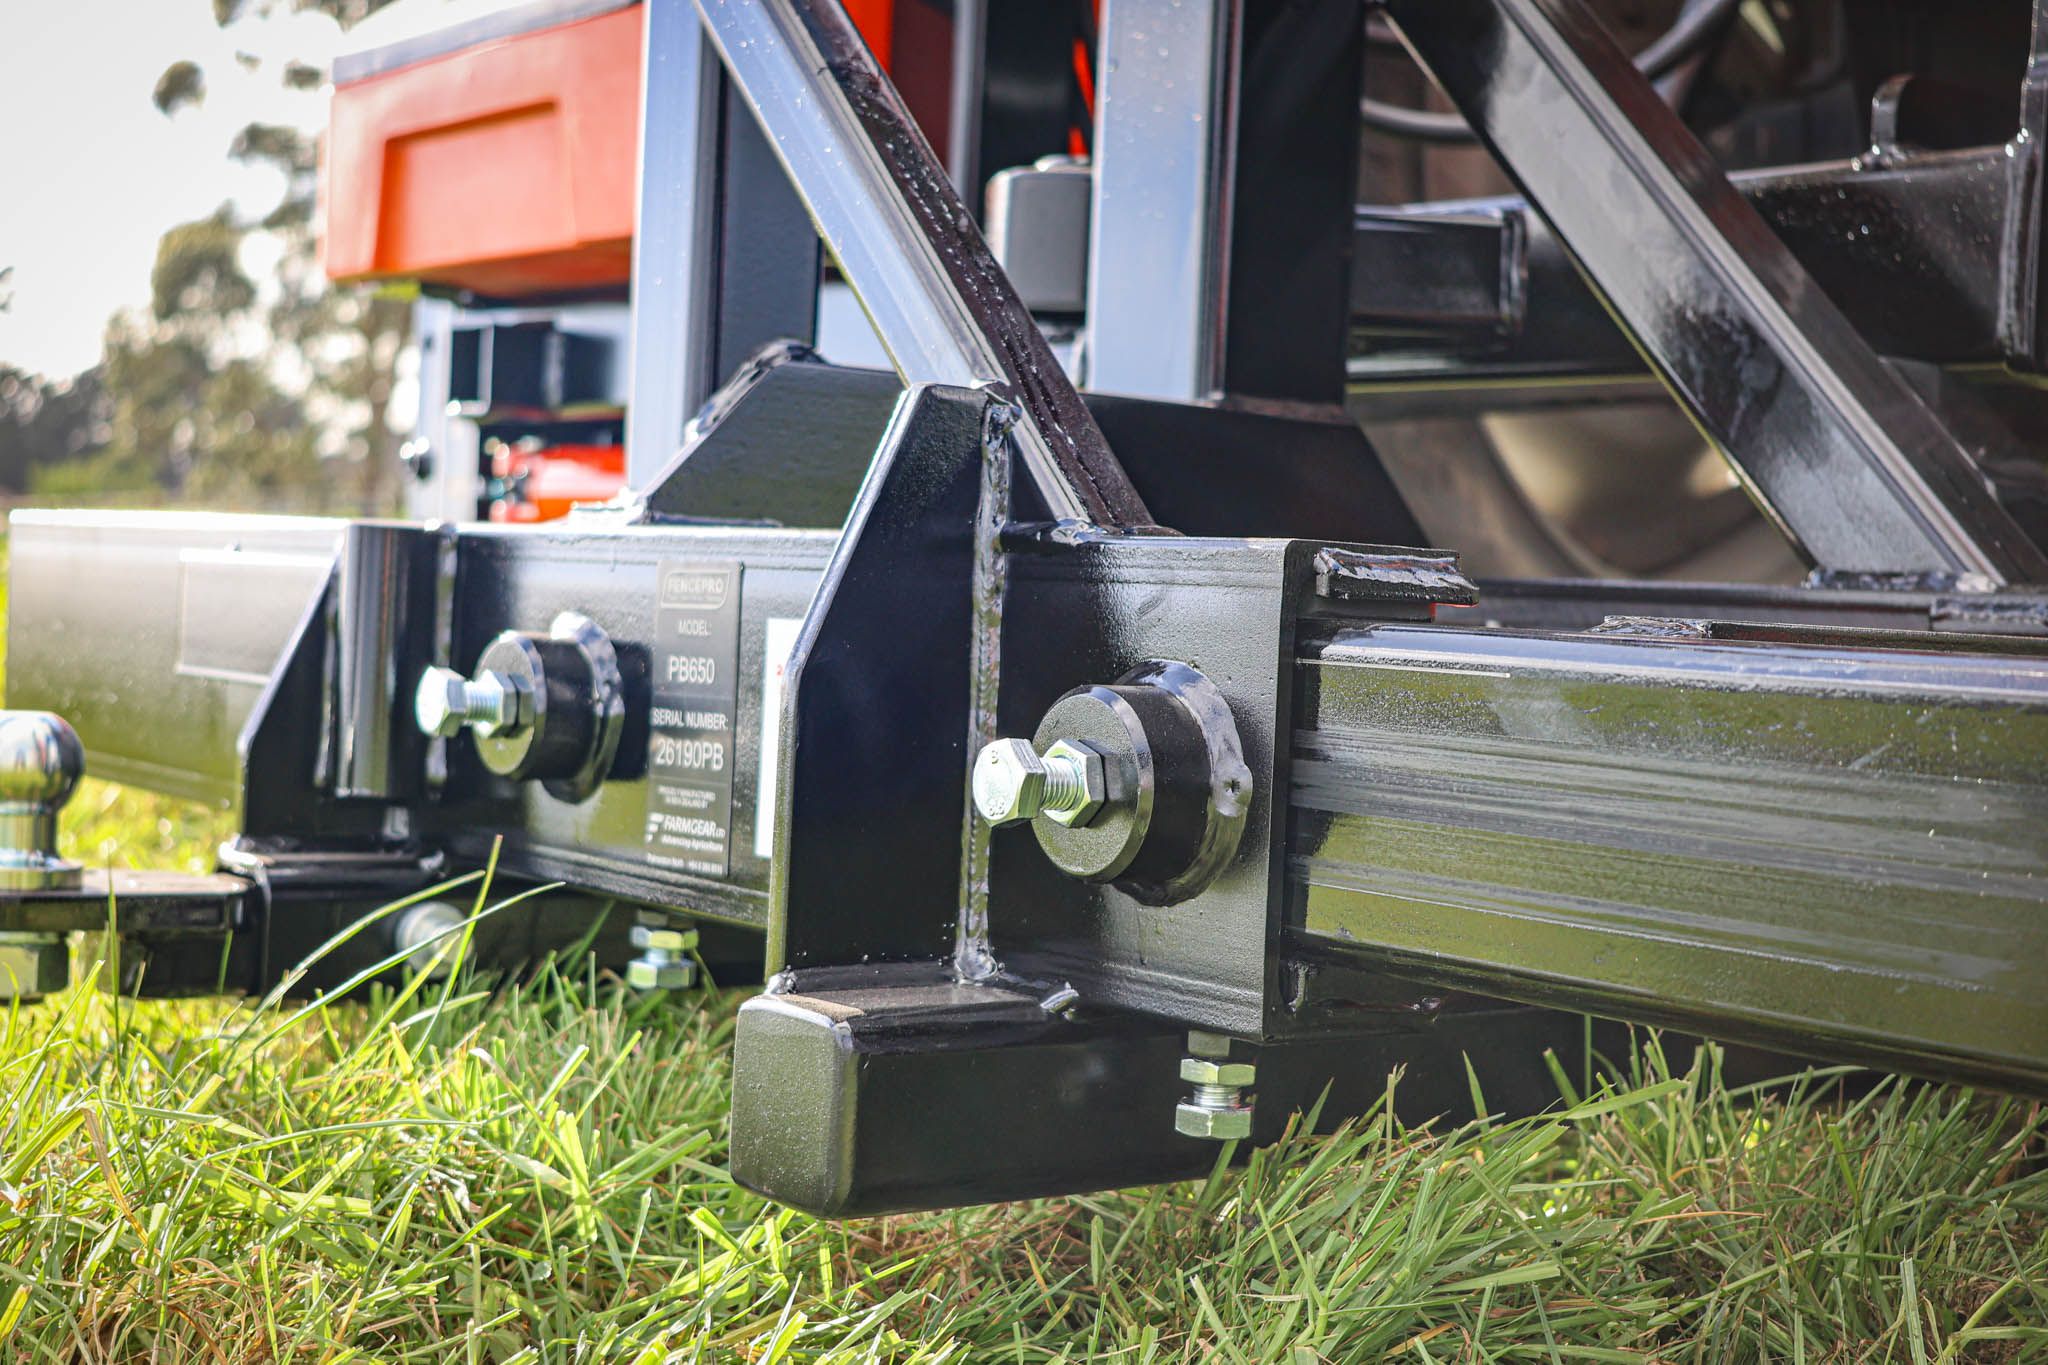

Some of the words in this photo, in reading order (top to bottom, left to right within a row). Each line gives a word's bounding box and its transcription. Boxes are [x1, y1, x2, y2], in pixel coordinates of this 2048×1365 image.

[678, 619, 712, 636] MODEL:
[668, 655, 715, 684] PB650
[652, 706, 684, 728] SERIAL
[686, 710, 729, 731] NUMBER:
[655, 738, 724, 771] 26190PB
[663, 814, 717, 838] FARMGEAR
